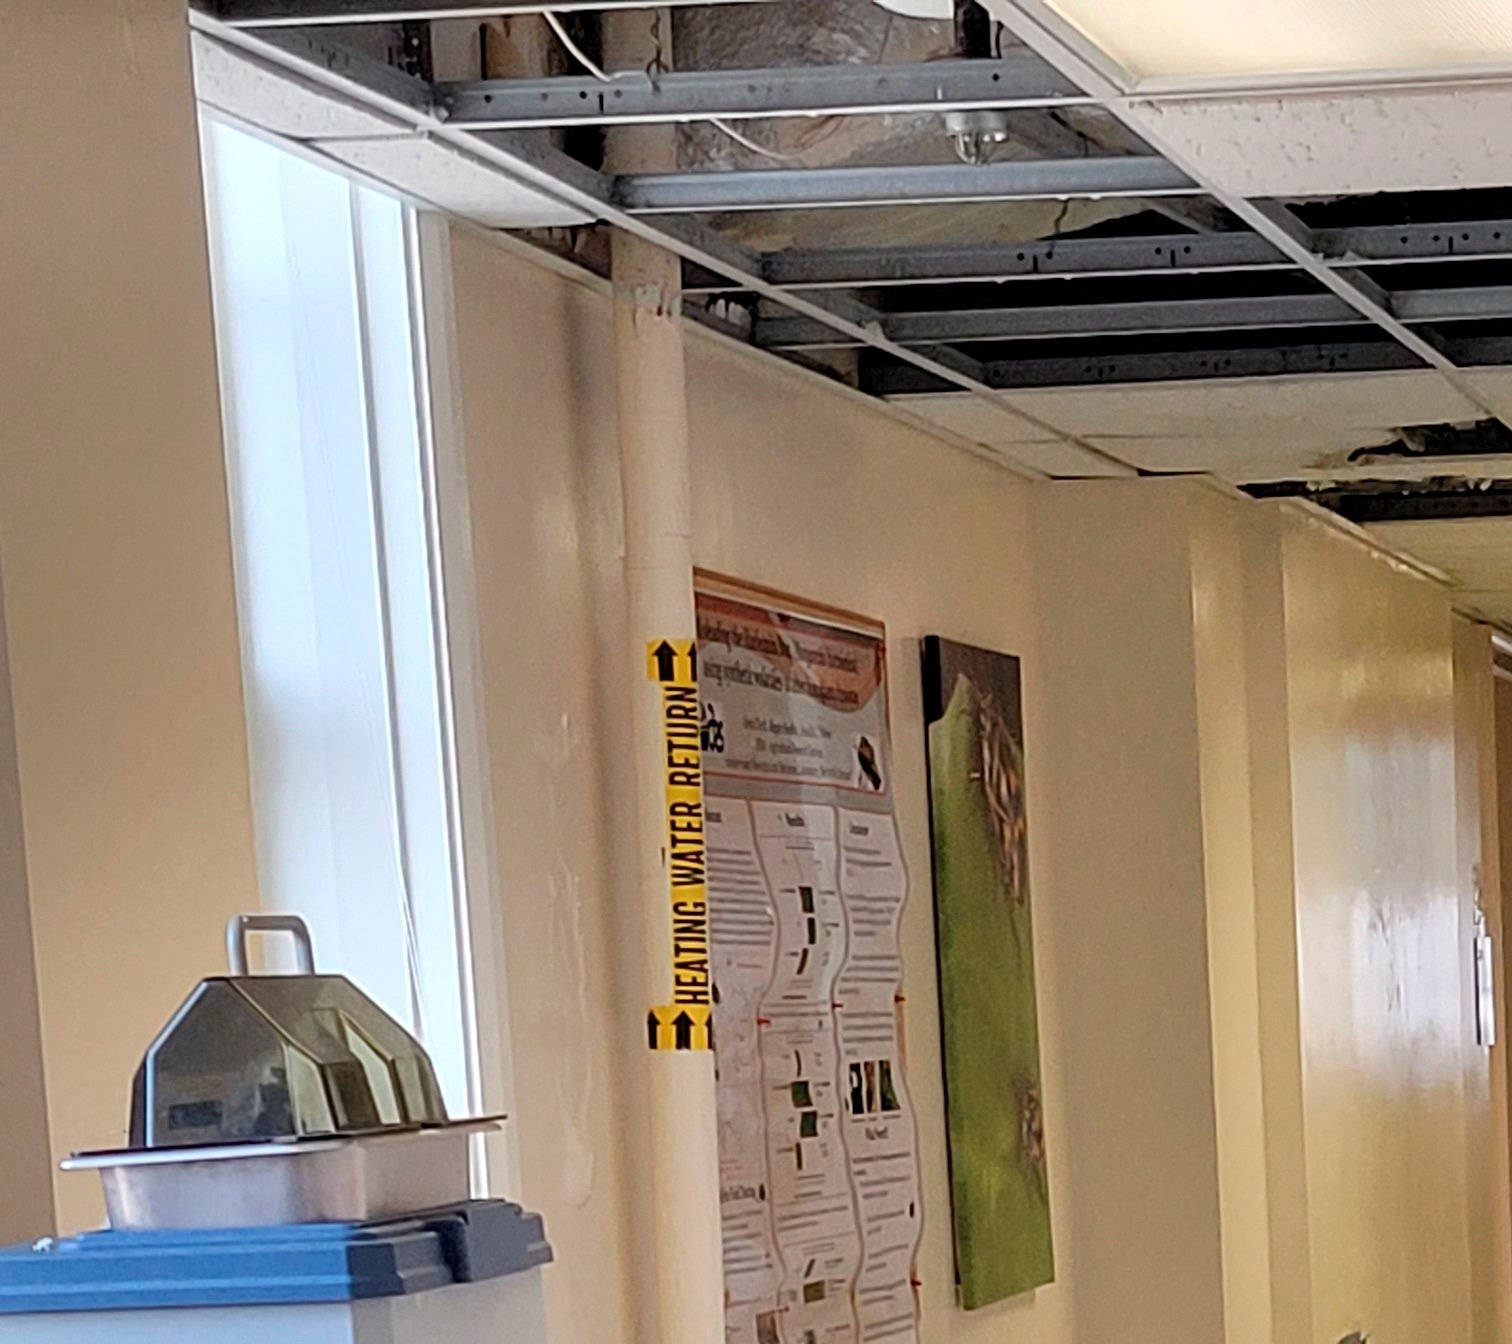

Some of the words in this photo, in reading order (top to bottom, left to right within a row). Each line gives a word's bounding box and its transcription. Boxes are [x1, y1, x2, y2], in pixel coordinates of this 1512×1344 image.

[665, 686, 701, 787] RETURN
[670, 801, 705, 886] WATER
[673, 901, 709, 1005] HEATING
